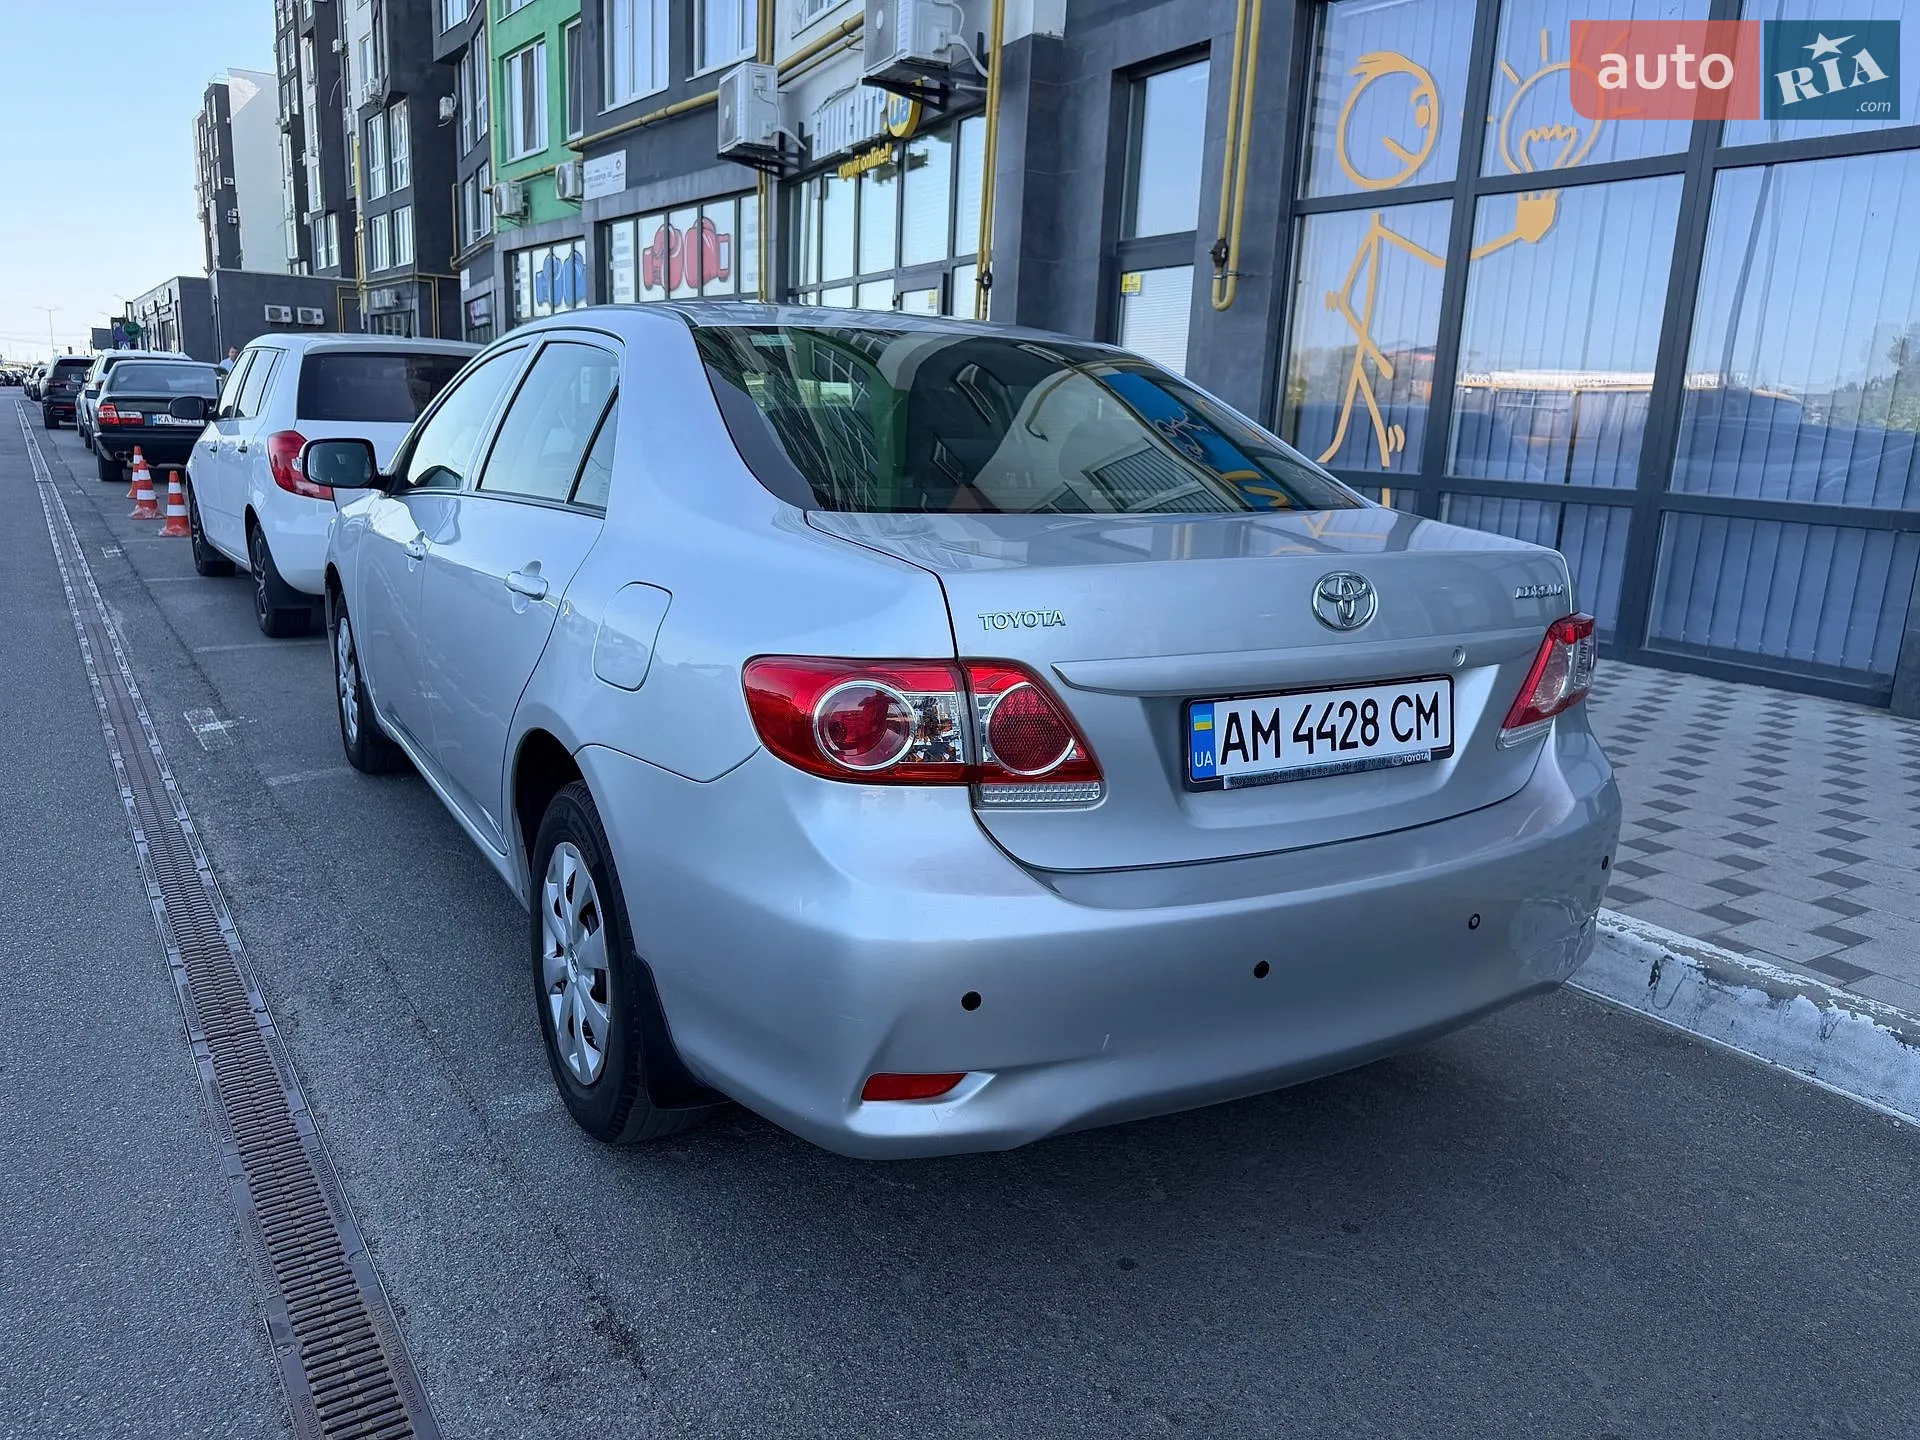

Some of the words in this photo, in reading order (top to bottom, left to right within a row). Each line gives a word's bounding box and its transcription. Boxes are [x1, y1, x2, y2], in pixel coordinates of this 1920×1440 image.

[977, 609, 1066, 631] TOYOTA
[1220, 707, 1281, 766] AM
[1292, 698, 1380, 755] 4428
[1389, 691, 1440, 743] CM
[1194, 751, 1214, 768] UA
[1403, 752, 1430, 764] TOYOTA
